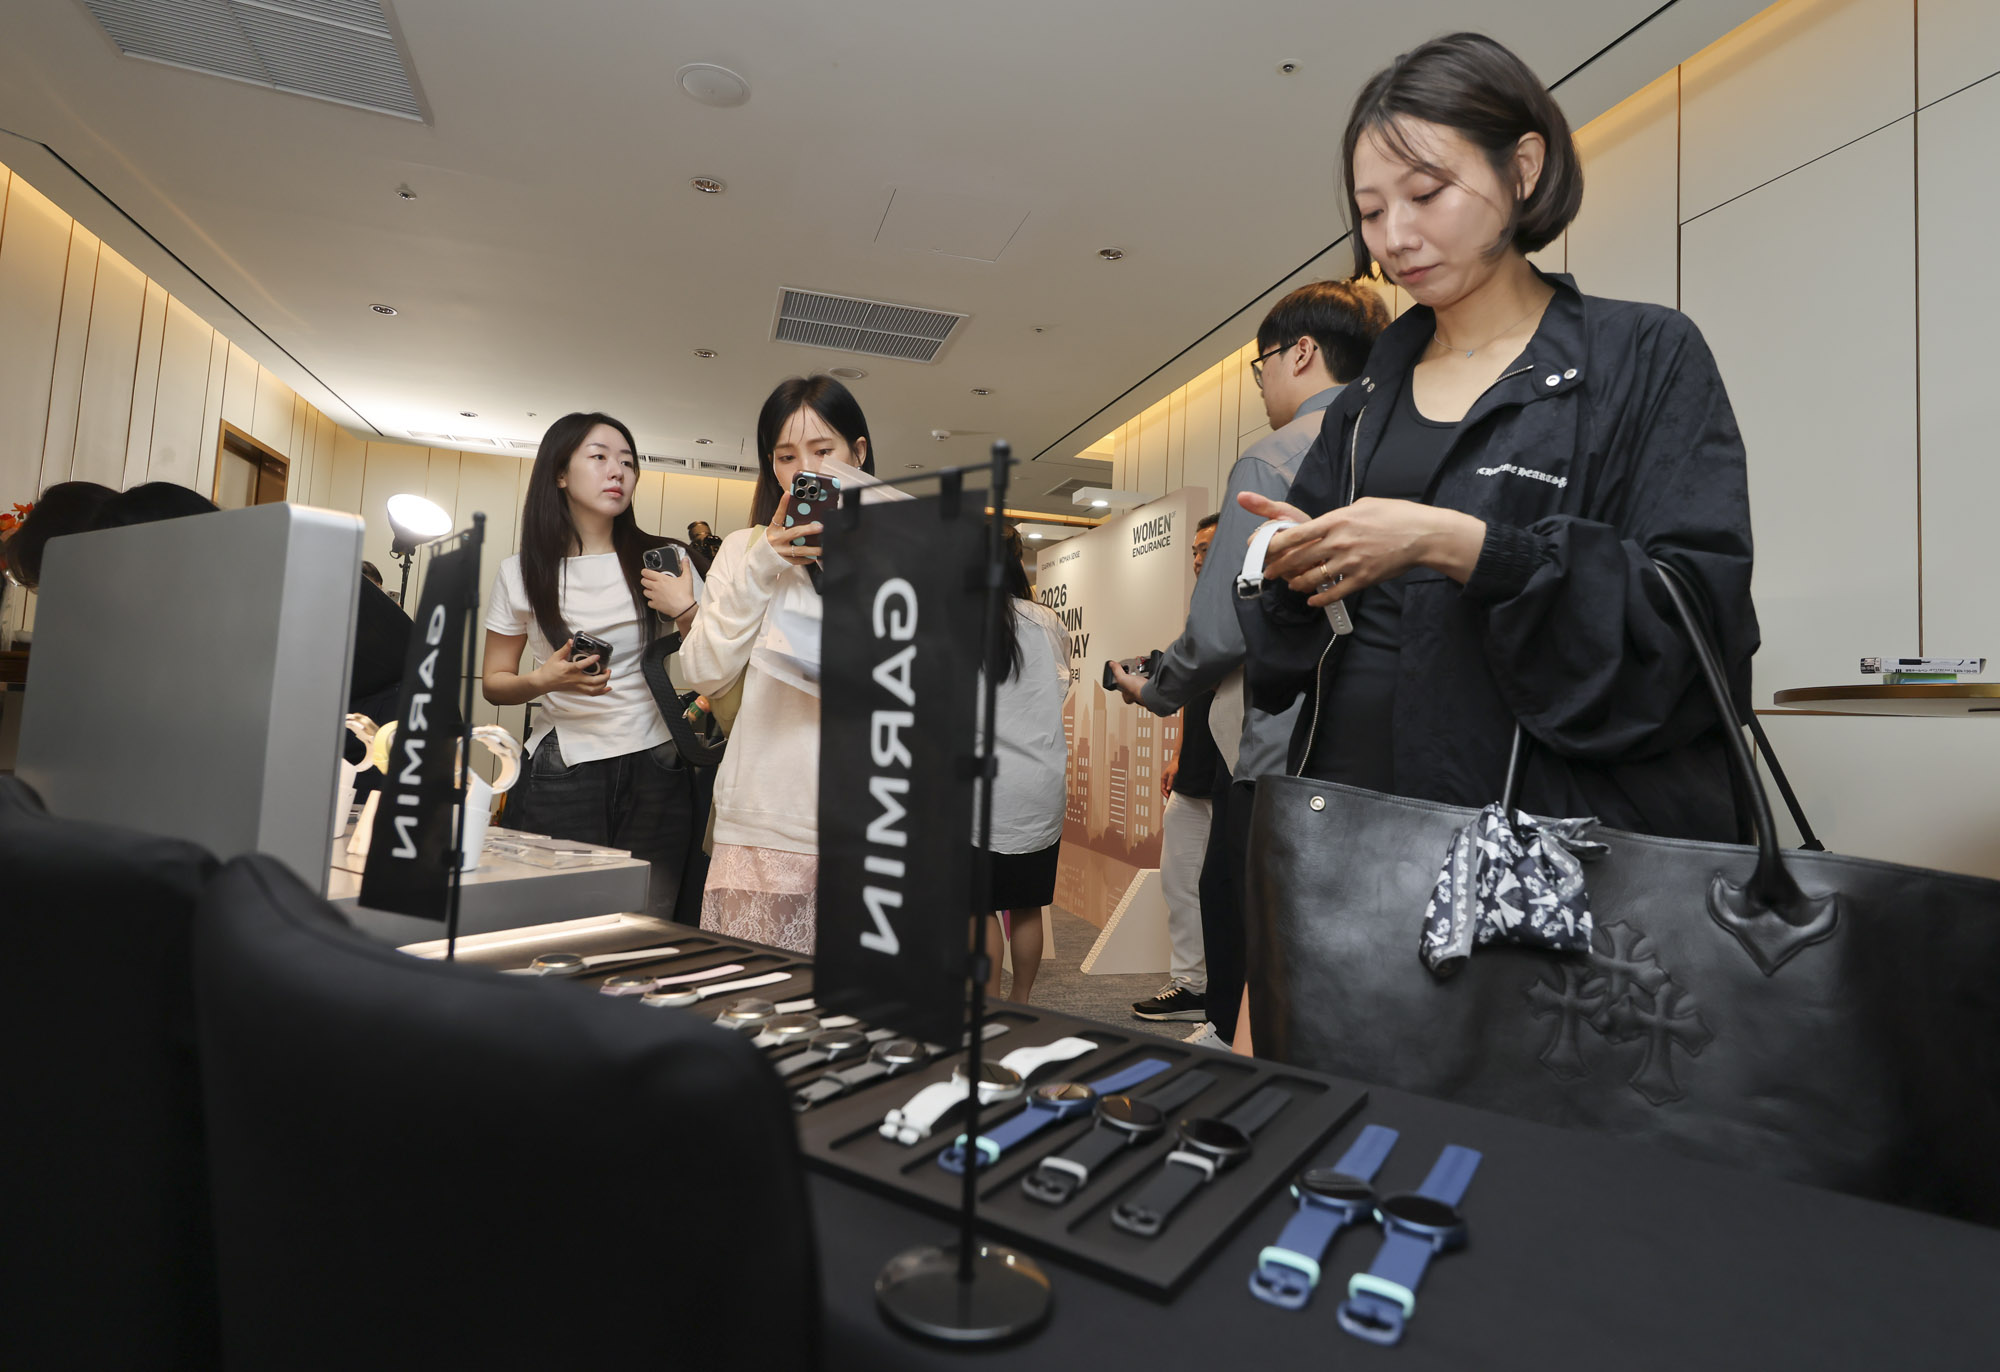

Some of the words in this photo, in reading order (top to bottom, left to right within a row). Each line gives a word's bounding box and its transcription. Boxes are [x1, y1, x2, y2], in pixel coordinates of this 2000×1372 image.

[1133, 513, 1171, 545] WOMEN
[1133, 535, 1171, 558] ENDURANCE
[1041, 583, 1067, 608] 2026
